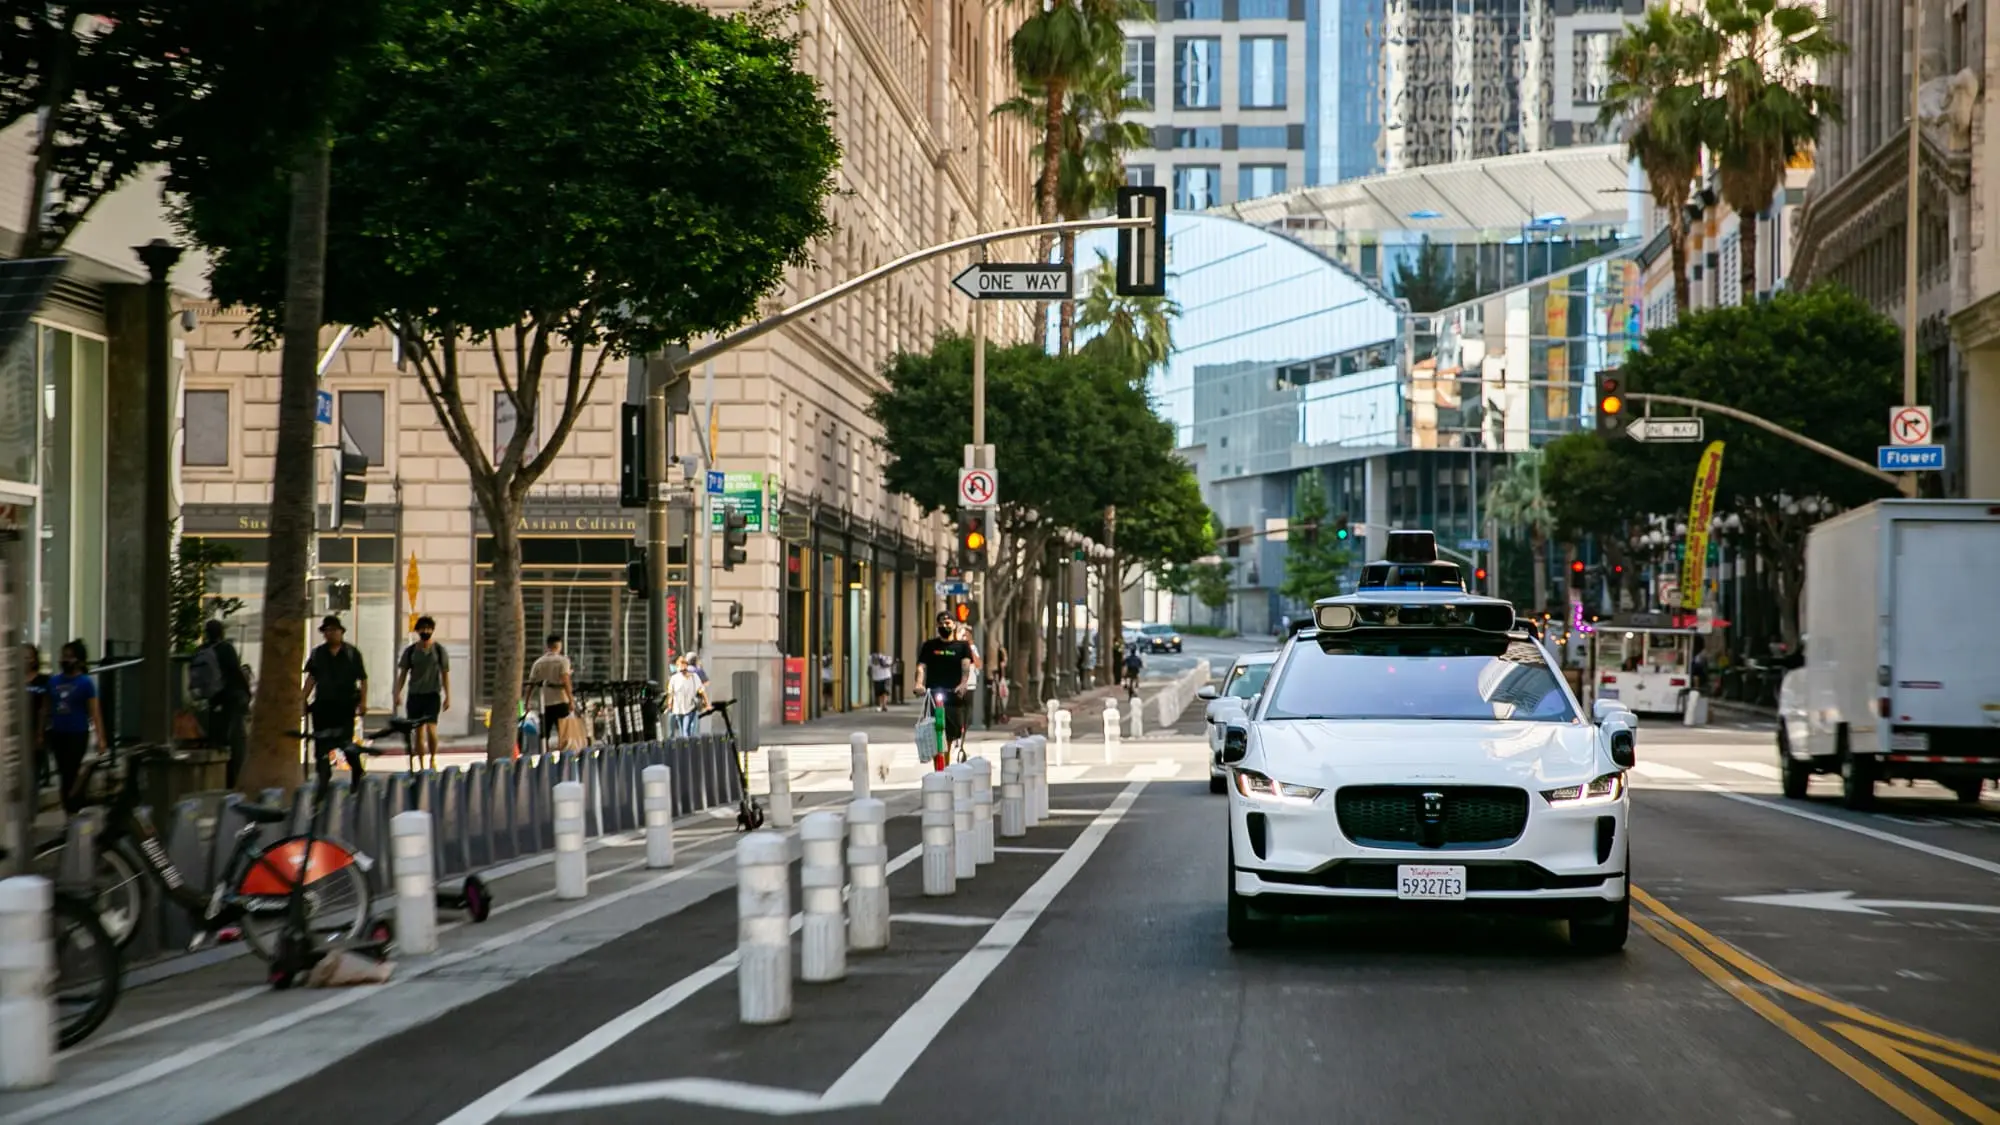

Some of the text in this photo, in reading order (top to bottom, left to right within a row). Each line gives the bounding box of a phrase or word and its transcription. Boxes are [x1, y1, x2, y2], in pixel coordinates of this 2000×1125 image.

[979, 274, 1061, 290] ONE WAY
[1672, 424, 1696, 434] WAY
[1886, 450, 1937, 465] Flower
[239, 515, 268, 529] Sus
[517, 516, 636, 530] Asian Cuisin
[1402, 878, 1462, 895] 59327E3
